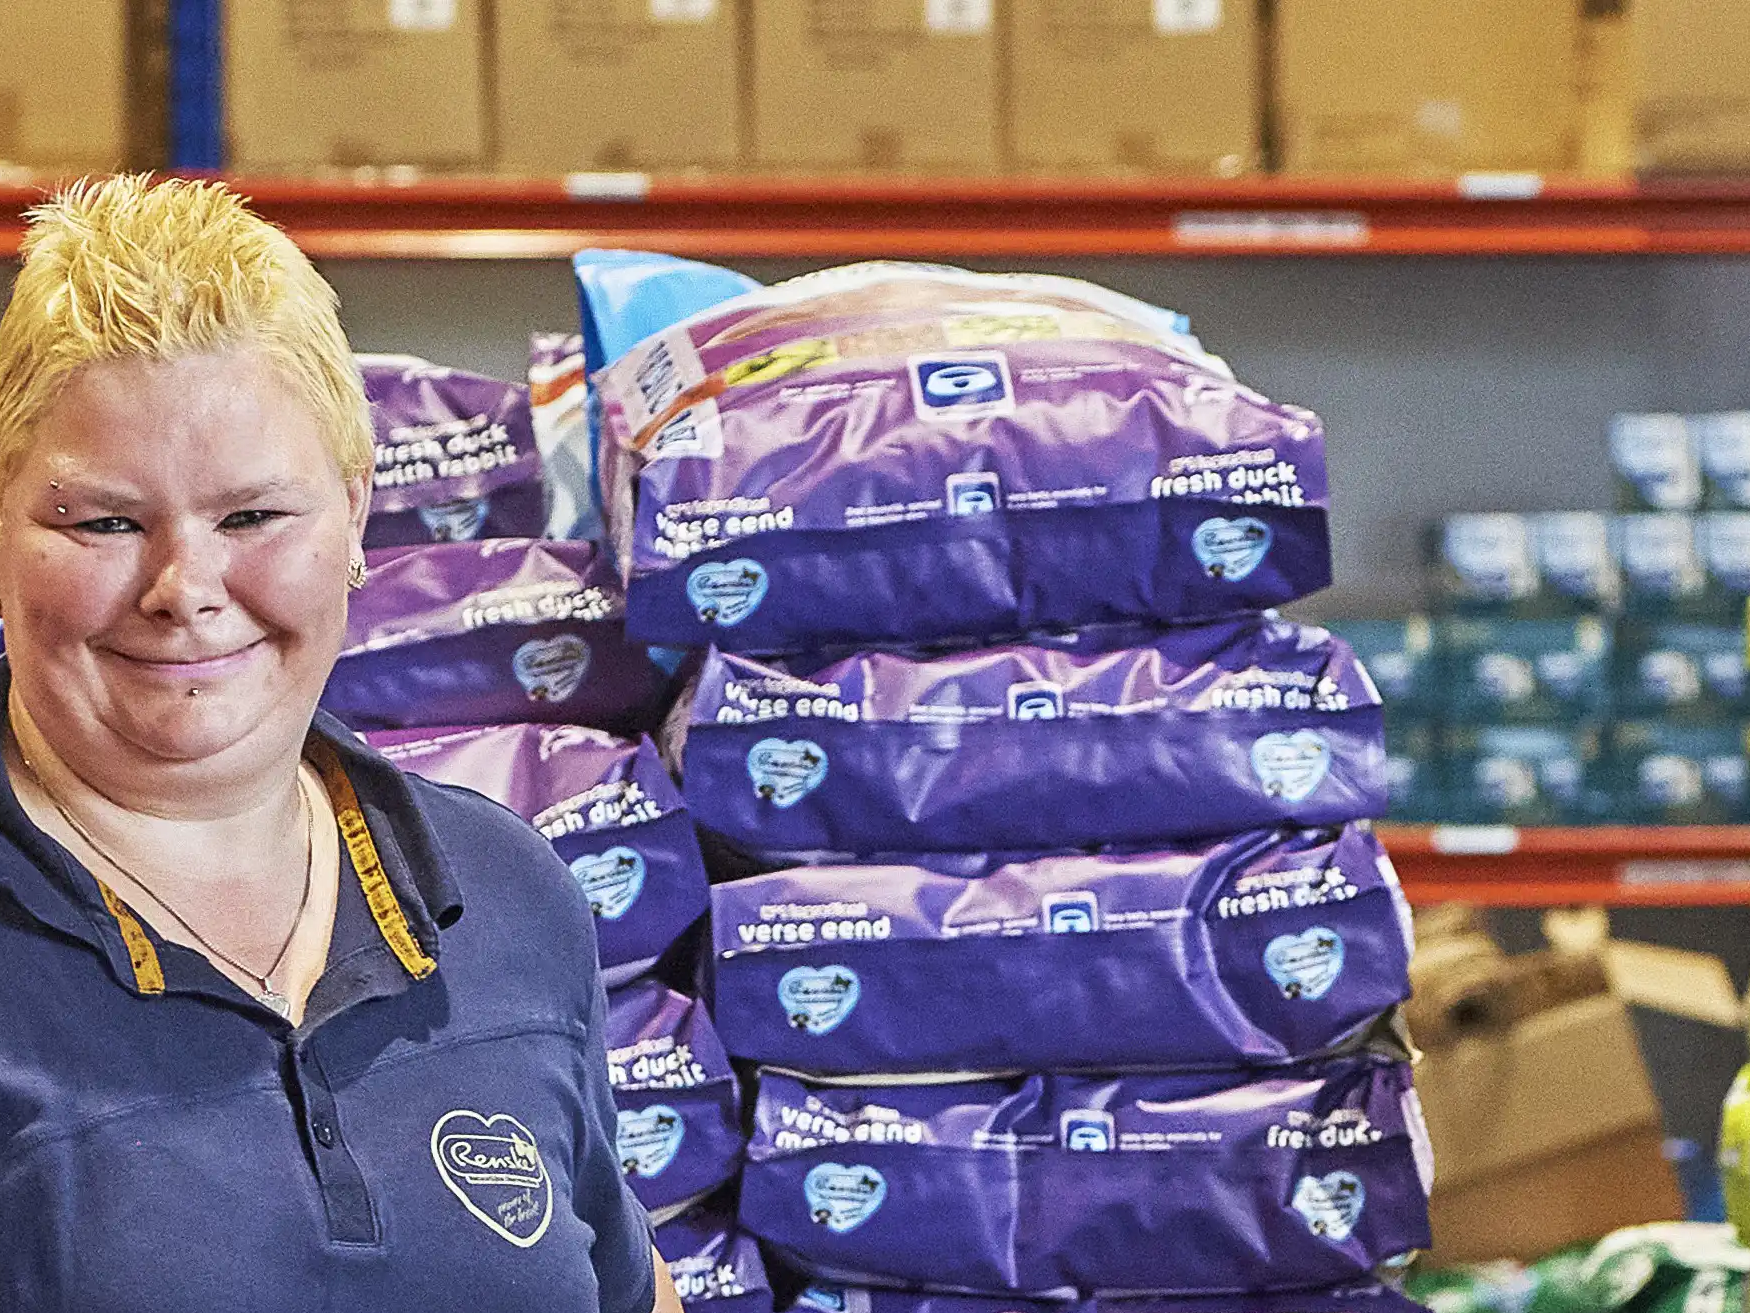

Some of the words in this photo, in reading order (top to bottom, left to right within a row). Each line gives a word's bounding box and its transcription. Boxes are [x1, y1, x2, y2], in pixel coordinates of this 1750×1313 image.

[446, 423, 509, 452] duck
[374, 461, 435, 489] with
[438, 446, 518, 479] rabbit
[1150, 470, 1223, 500] fresh
[1226, 459, 1298, 491] duck
[723, 505, 794, 535] eend
[1217, 885, 1291, 921] fresh
[737, 921, 816, 945] verse
[819, 914, 892, 942] eend
